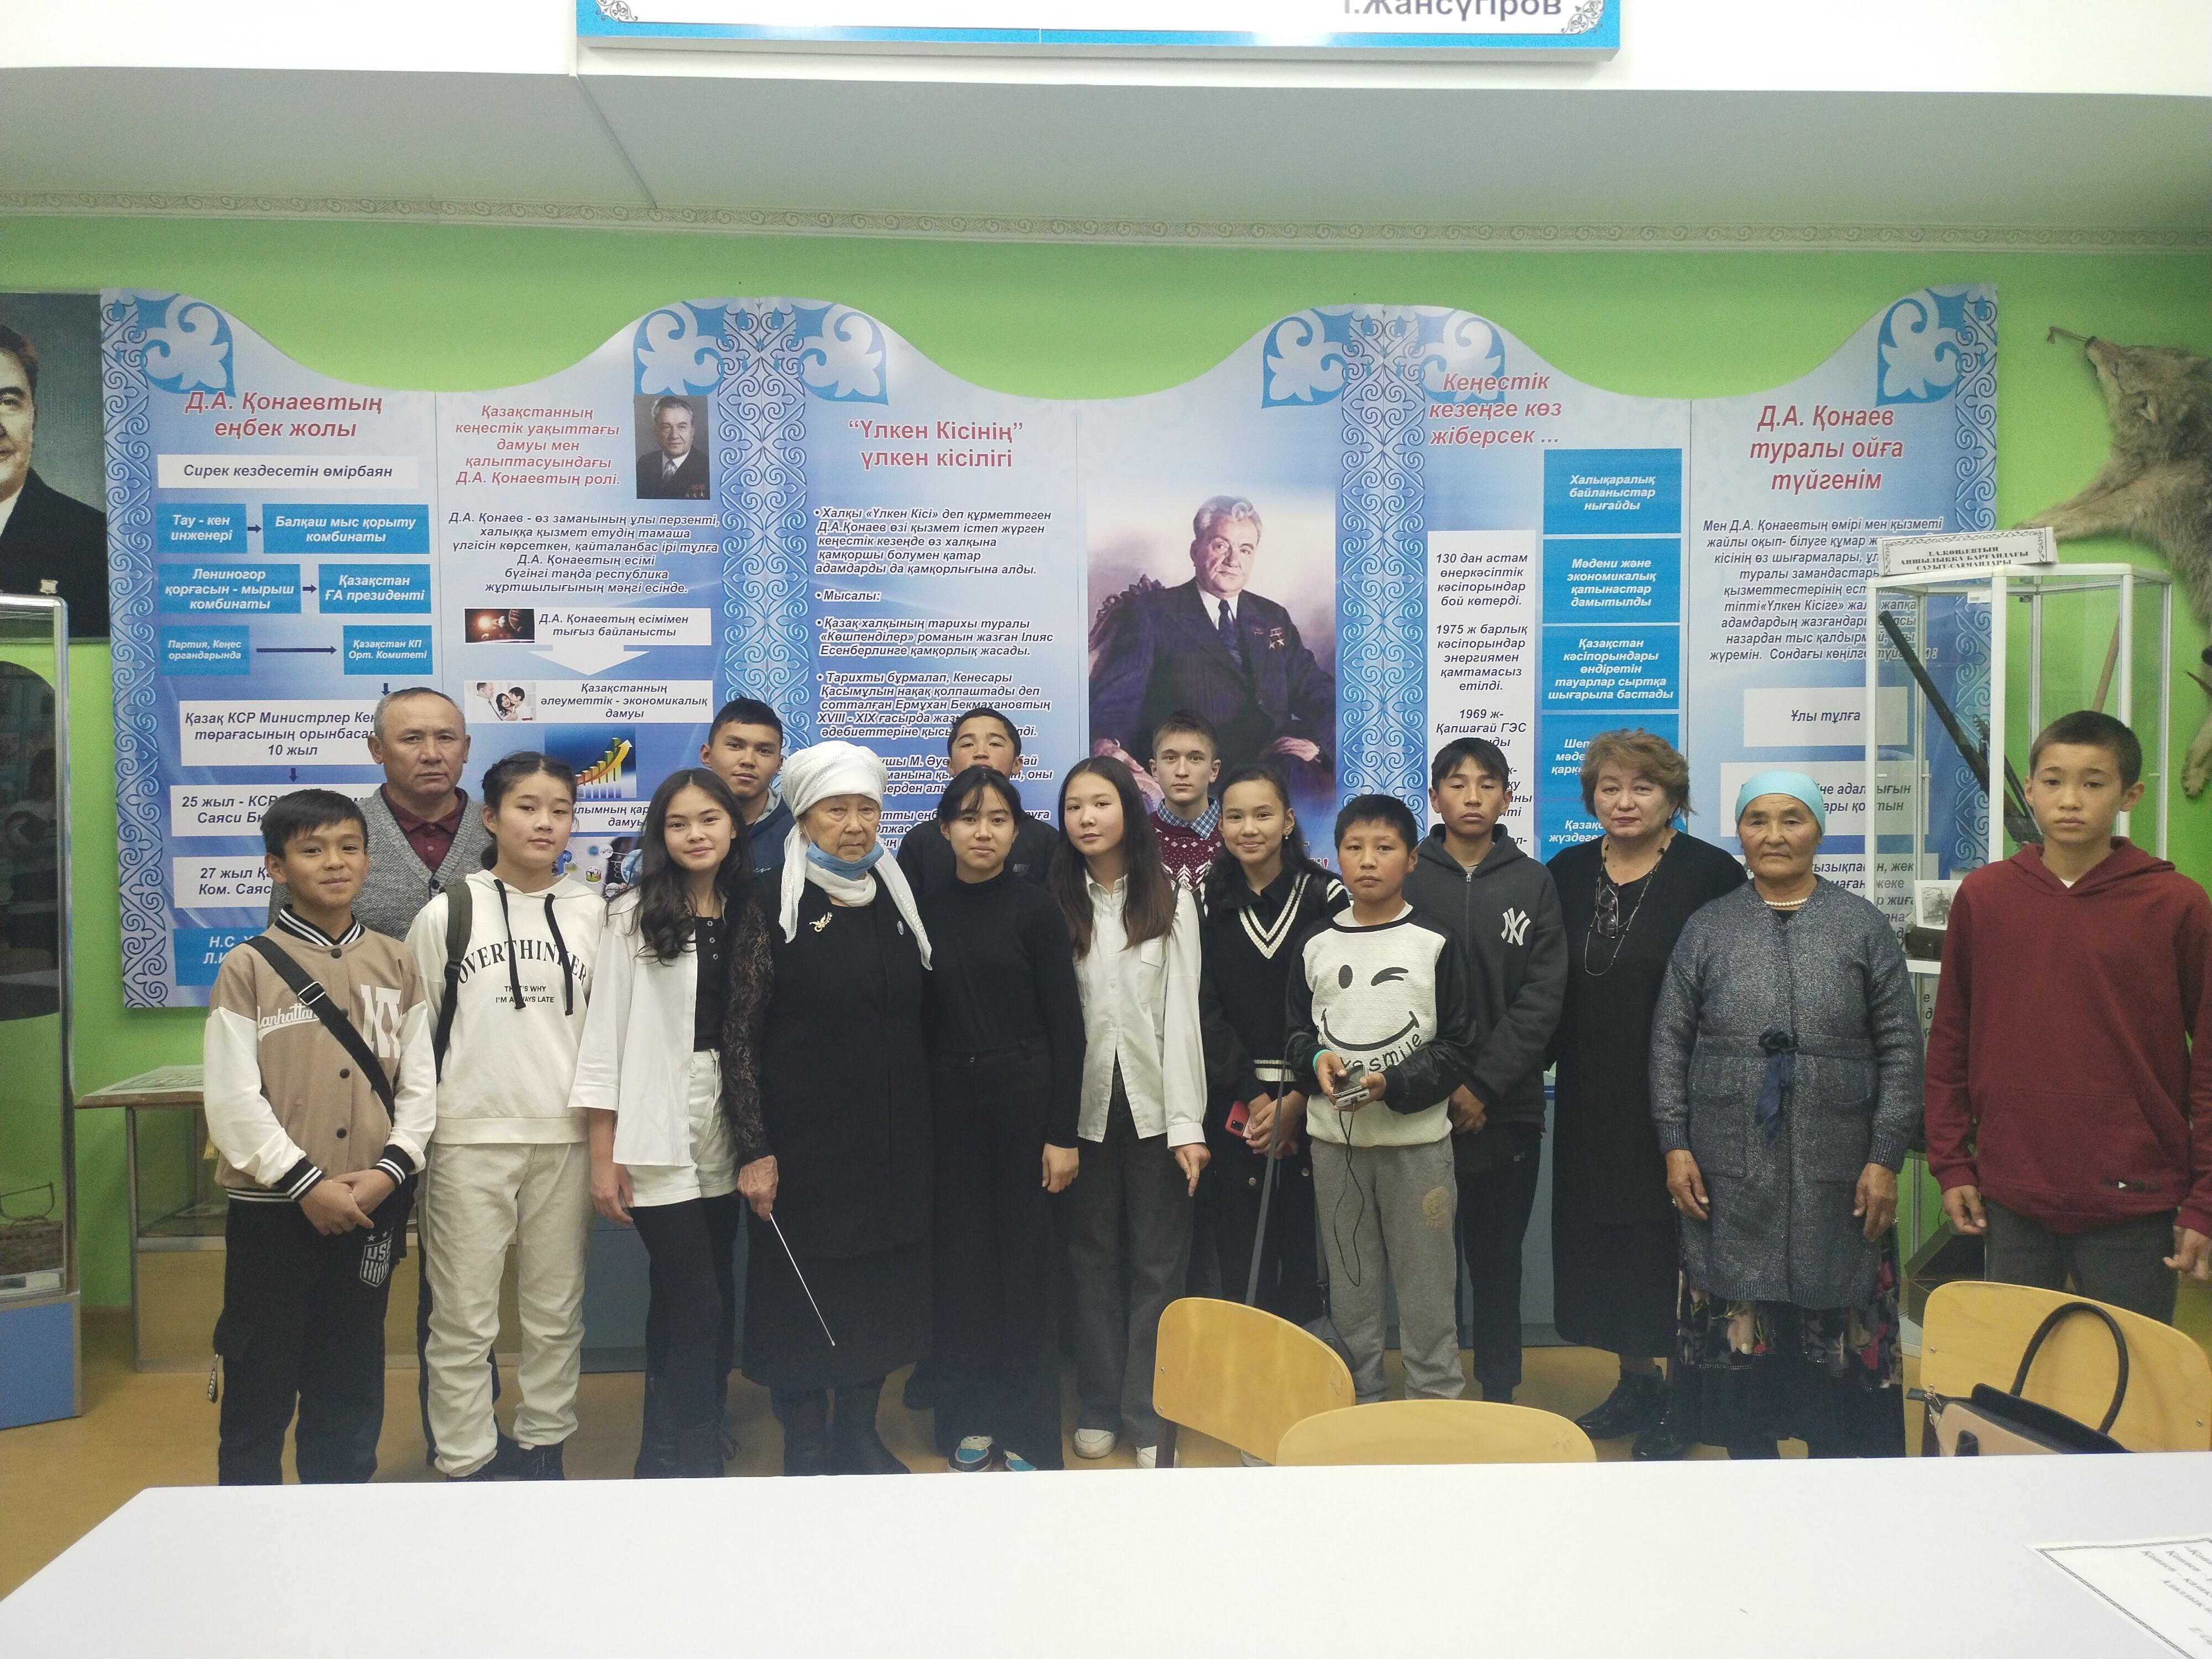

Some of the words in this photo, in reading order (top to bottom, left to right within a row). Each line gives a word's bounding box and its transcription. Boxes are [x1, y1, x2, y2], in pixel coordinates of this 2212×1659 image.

[1443, 373, 1550, 394] Кеңестік
[185, 392, 233, 414] Д.А.
[243, 393, 382, 414] Қонаевтың
[482, 406, 593, 420] Қазақстанның
[1429, 404, 1517, 420] кезеңге
[1525, 403, 1562, 417] көз
[1757, 406, 1803, 431] Д.А.
[1813, 406, 1894, 431] Қонаев
[215, 421, 283, 439] еңбек
[289, 422, 357, 437] жолы
[456, 424, 523, 435] кеңестік
[527, 426, 619, 437] уақыттағы
[1430, 426, 1535, 448] жіберсек
[497, 440, 546, 452] дамуы
[552, 442, 580, 451] мен
[1750, 442, 1844, 463] туралы
[1853, 437, 1903, 458] ойға
[466, 457, 611, 470] қалыптасуындағы
[860, 452, 928, 469] үлкен
[937, 449, 1012, 467] кісілігі
[184, 465, 228, 478] Сирек
[234, 466, 318, 478] кездесетін
[324, 466, 392, 478] өмірбаян
[456, 472, 487, 486] Д.А.
[492, 472, 580, 486] Қонаевтың
[585, 474, 620, 487] ролі.
[1570, 476, 1655, 486] Халықаралық
[1772, 468, 1881, 495] түйгенім
[1570, 488, 1656, 499] байланыстар
[1584, 501, 1640, 510] нығайды
[822, 508, 862, 519] Халқы
[867, 509, 907, 518] «Үлкен
[911, 509, 938, 518] Кісі»
[942, 509, 963, 520] деп
[967, 510, 1051, 521] құрметтеген
[275, 517, 326, 529] Балқаш
[331, 518, 359, 528] мыс
[363, 518, 416, 530] қорыту
[817, 523, 886, 534] Д.А.Қонаев
[890, 524, 907, 533] өзі
[911, 525, 959, 534] қызмет
[963, 524, 998, 534] істеп
[1001, 525, 1045, 534] жүрген
[1703, 521, 1728, 531] Мен
[1729, 520, 1754, 533] Д.А.
[1758, 520, 1828, 532] Қонаевтың
[1832, 519, 1861, 531] өмірі
[1865, 521, 1887, 530] мен
[1891, 519, 1942, 531] қызметі
[171, 531, 232, 543] инженері
[306, 532, 386, 542] комбинаты
[481, 528, 533, 539] халыққа
[536, 529, 587, 539] қызмет
[592, 529, 634, 539] етудің
[639, 530, 690, 539] тамаша
[517, 555, 543, 566] Д.А.
[547, 556, 620, 567] Қонаевтың
[624, 556, 655, 565] есімі
[1436, 554, 1456, 563] 130
[1460, 554, 1483, 562] дан
[1572, 559, 1618, 568] Мәдени
[192, 569, 265, 582] Лениногор
[1441, 568, 1523, 580] өнеркәсіптік
[1567, 572, 1656, 582] экономикалық
[340, 575, 410, 588] Қазақстан
[486, 582, 604, 594] жұртшылығының
[608, 583, 641, 594] мәңгі
[646, 584, 687, 593] есінде.
[1438, 582, 1525, 594] кәсіпорындар
[1571, 586, 1651, 595] қатынастар
[347, 591, 425, 603] президенті
[824, 591, 880, 601] Мысалы:
[1441, 596, 1463, 606] бой
[1468, 597, 1521, 608] көтерді.
[190, 599, 270, 609] комбинаты
[1571, 598, 1651, 608] дамытылды
[540, 614, 562, 625] Д.А.
[567, 615, 635, 626] Қонаевтың
[639, 615, 688, 624] есімімен
[825, 618, 858, 629] Қазақ
[862, 620, 924, 630] халқының
[928, 620, 977, 630] тарихы
[981, 620, 1029, 630] туралы
[553, 628, 594, 637] тығыз
[598, 627, 676, 636] байланысты
[1436, 625, 1464, 634] 1975
[1480, 624, 1527, 636] барлық
[821, 632, 914, 644] «Көшпенділер»
[917, 633, 973, 644] романын
[976, 633, 1018, 642] жазған
[1021, 633, 1053, 642] Ілияс
[1579, 639, 1644, 649] Қазақстан
[168, 640, 211, 650] Партия,
[213, 640, 241, 650] Кеңес
[354, 640, 406, 650] Қазақстан
[821, 645, 907, 657] Есенберлинге
[911, 647, 977, 657] қамқорлық
[981, 646, 1030, 656] жасады.
[1438, 639, 1525, 651] кәсіпорындар
[169, 650, 241, 662] органдарында
[377, 650, 427, 660] Комитеті
[1444, 654, 1519, 665] энергиямен
[1563, 652, 1658, 662] кәсіпорындары
[1441, 668, 1521, 677] қамтамасыз
[1580, 665, 1641, 675] өндіретін
[828, 673, 883, 684] Тарихты
[888, 672, 950, 684] бұрмалап,
[953, 674, 1012, 684] Кенесары
[1556, 679, 1615, 688] тауарлар
[1618, 679, 1666, 688] сыртқа
[581, 684, 667, 693] Қазақстанның
[1459, 681, 1503, 692] етілді.
[1548, 691, 1613, 701] шығарыла
[1617, 690, 1673, 701] бастады
[822, 701, 891, 710] сотталған
[895, 701, 947, 712] Ермұхан
[951, 700, 1050, 711] Бекмахановтың
[606, 709, 644, 719] дамуы
[1459, 709, 1486, 718] 1969
[1791, 710, 1817, 721] Ұлы
[1821, 711, 1861, 723] тұлға
[1436, 723, 1496, 734] Қапшағай
[1500, 723, 1526, 733] ГЭС
[268, 745, 282, 755] 10
[287, 746, 317, 755] жыл
